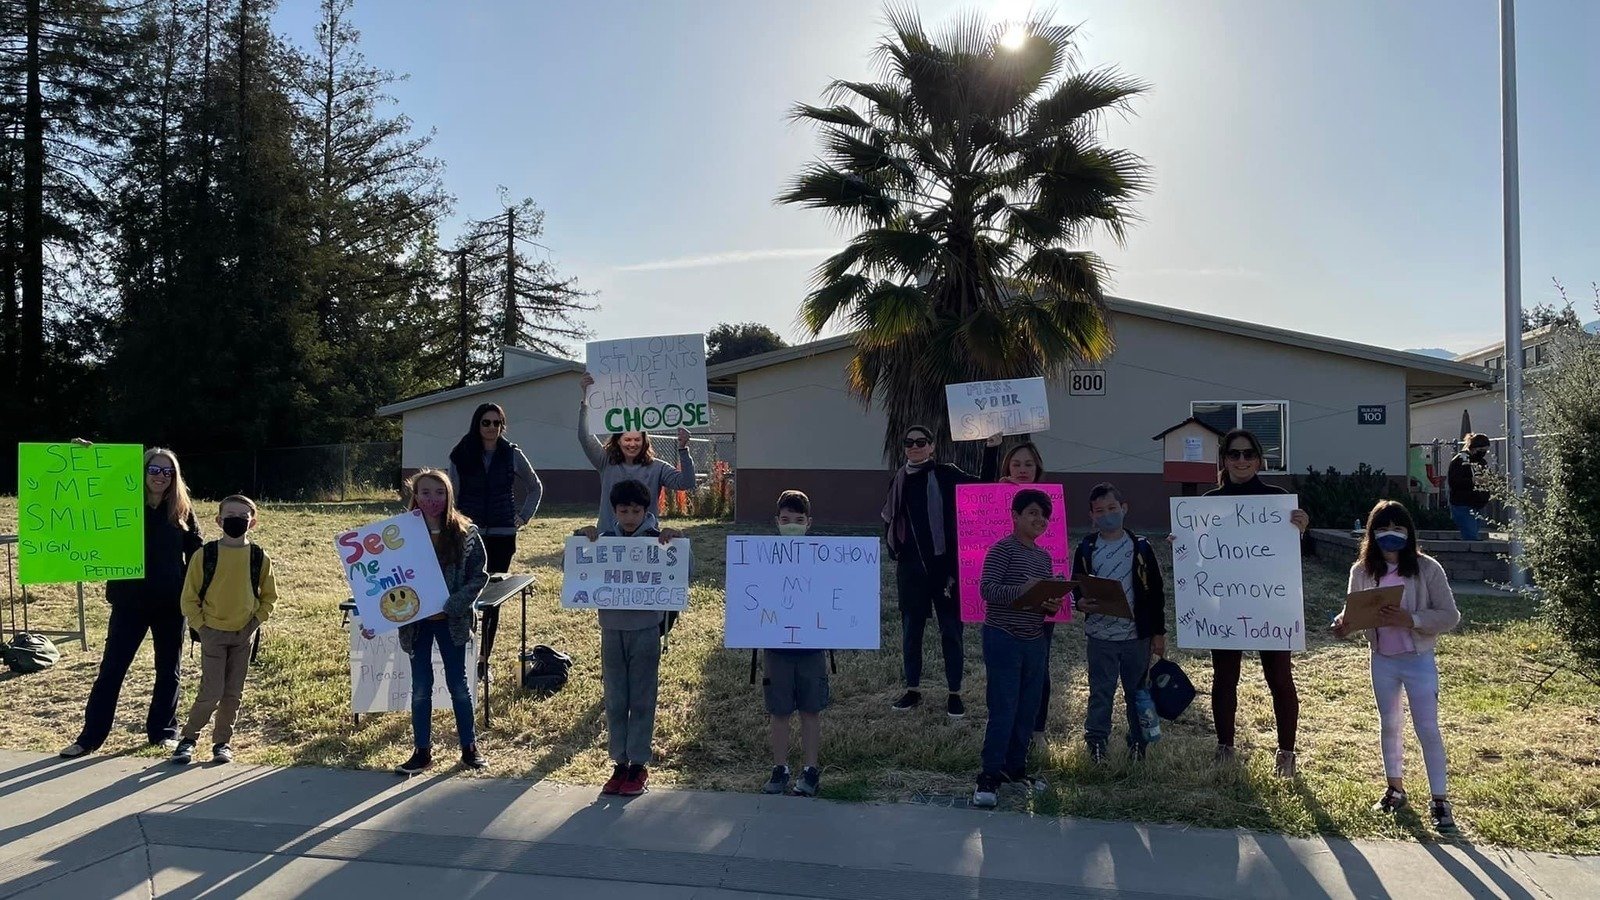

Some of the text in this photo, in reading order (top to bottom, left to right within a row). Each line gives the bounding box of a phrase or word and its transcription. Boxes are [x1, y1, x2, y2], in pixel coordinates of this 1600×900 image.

[648, 336, 690, 354] OUR
[600, 351, 698, 375] STUDENTS
[610, 371, 684, 390] HAVE A
[1073, 375, 1103, 391] 800
[588, 387, 696, 409] CHANCE TO
[974, 394, 1022, 410] YOUR
[605, 403, 708, 432] CHOOSE
[961, 406, 1047, 439] SMILE
[1363, 412, 1382, 421] 100
[47, 444, 112, 474] SEE
[55, 477, 103, 500] ME
[960, 488, 996, 504] Some
[1176, 501, 1282, 531] Give Kids
[22, 539, 72, 555] SIGN
[339, 524, 405, 564] See
[733, 539, 878, 565] I WANT TO SHOW
[1197, 533, 1275, 560] Choice
[69, 549, 102, 562] OUR
[575, 545, 678, 567] LET US
[604, 569, 662, 586] HAVE
[782, 576, 812, 595] MY
[1177, 571, 1286, 598] to Remove
[573, 585, 686, 607] A CHOICE
[1195, 617, 1236, 639] Mask
[357, 633, 399, 656] MAS
[361, 665, 405, 681] Please
